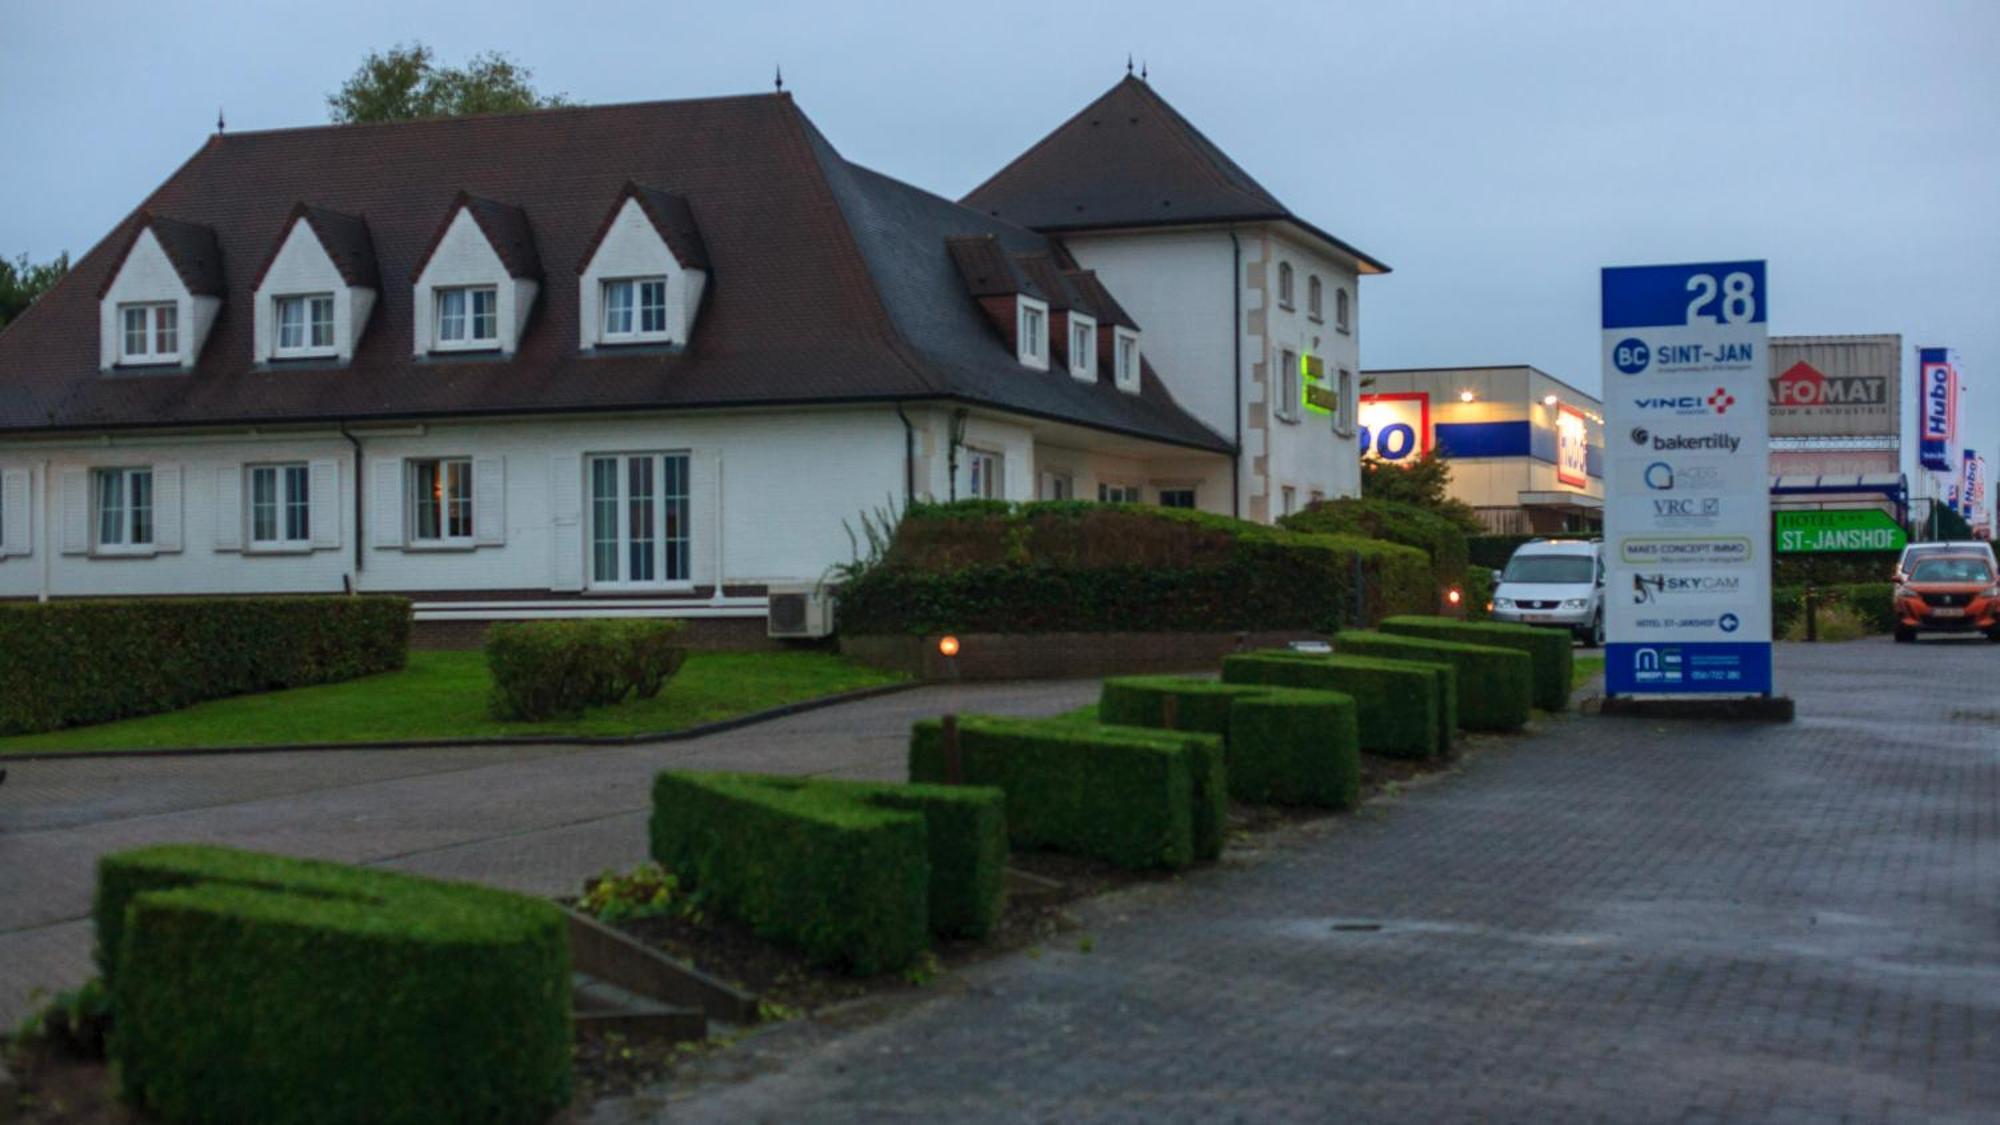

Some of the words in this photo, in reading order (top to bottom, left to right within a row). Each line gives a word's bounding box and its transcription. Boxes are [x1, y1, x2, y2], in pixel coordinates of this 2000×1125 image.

[1686, 272, 1756, 326] 28
[1617, 347, 1648, 366] BC
[1657, 343, 1753, 364] SINT-JAN
[1634, 396, 1704, 409] VINCI
[1929, 368, 1949, 434] Hubo
[1653, 433, 1741, 454] bakertilly
[1964, 462, 1977, 503] Hubo
[1653, 499, 1694, 514] VRC
[1627, 543, 1657, 554] MAES
[1660, 543, 1711, 554] CONCEPT
[1713, 542, 1745, 553] IMMO
[1782, 529, 1897, 551] ST-JANSHOF
[1667, 576, 1740, 590] SKYCAM
